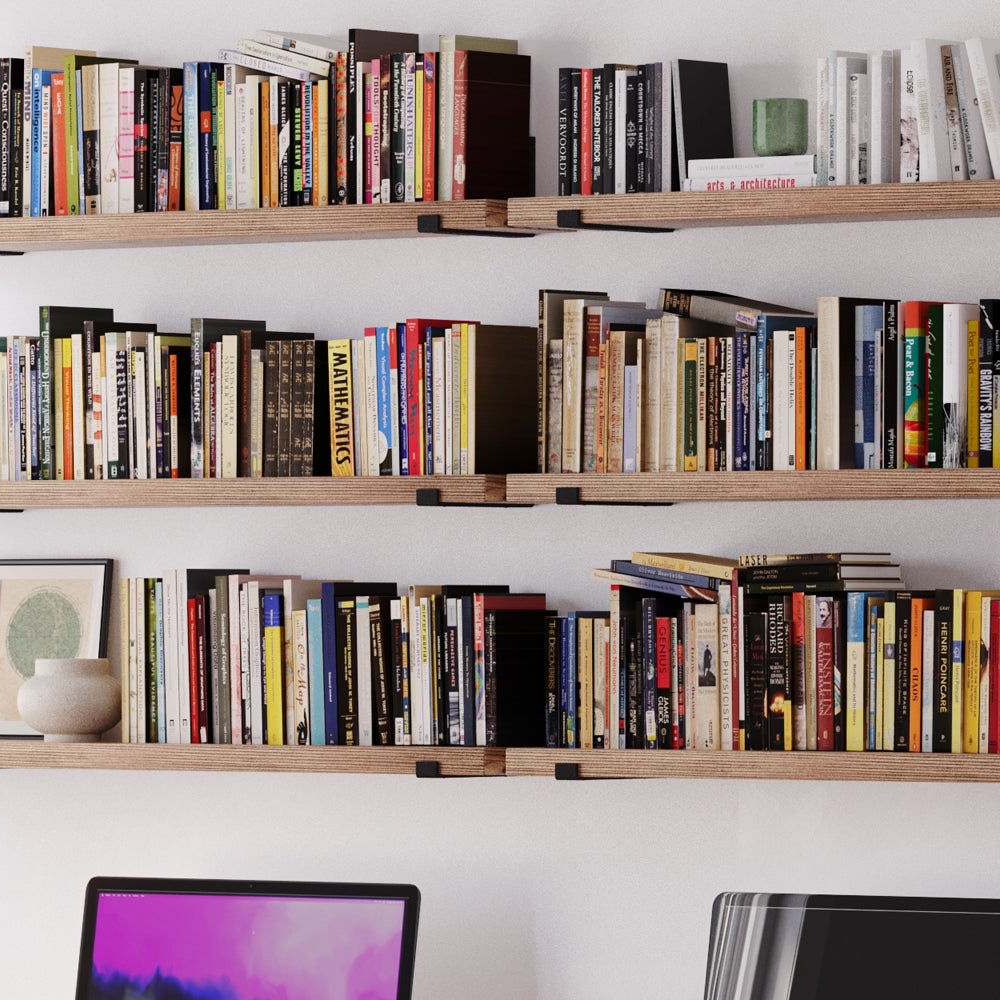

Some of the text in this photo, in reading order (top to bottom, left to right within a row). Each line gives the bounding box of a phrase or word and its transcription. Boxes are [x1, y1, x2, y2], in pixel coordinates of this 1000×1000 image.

[707, 180, 725, 192] arts
[740, 177, 796, 189] architecture
[905, 339, 914, 359] Pear
[968, 358, 976, 374] Poet
[332, 352, 351, 465] MATHEMATICS
[905, 370, 914, 396] Bacon
[980, 369, 992, 451] GRAVITY'S RAINBOW
[739, 554, 768, 567] LASER
[769, 603, 777, 654] RHODES
[776, 603, 784, 654] RICHARD
[822, 642, 832, 717] EINSTEIN
[940, 622, 948, 713] HENRI POINCARÉ
